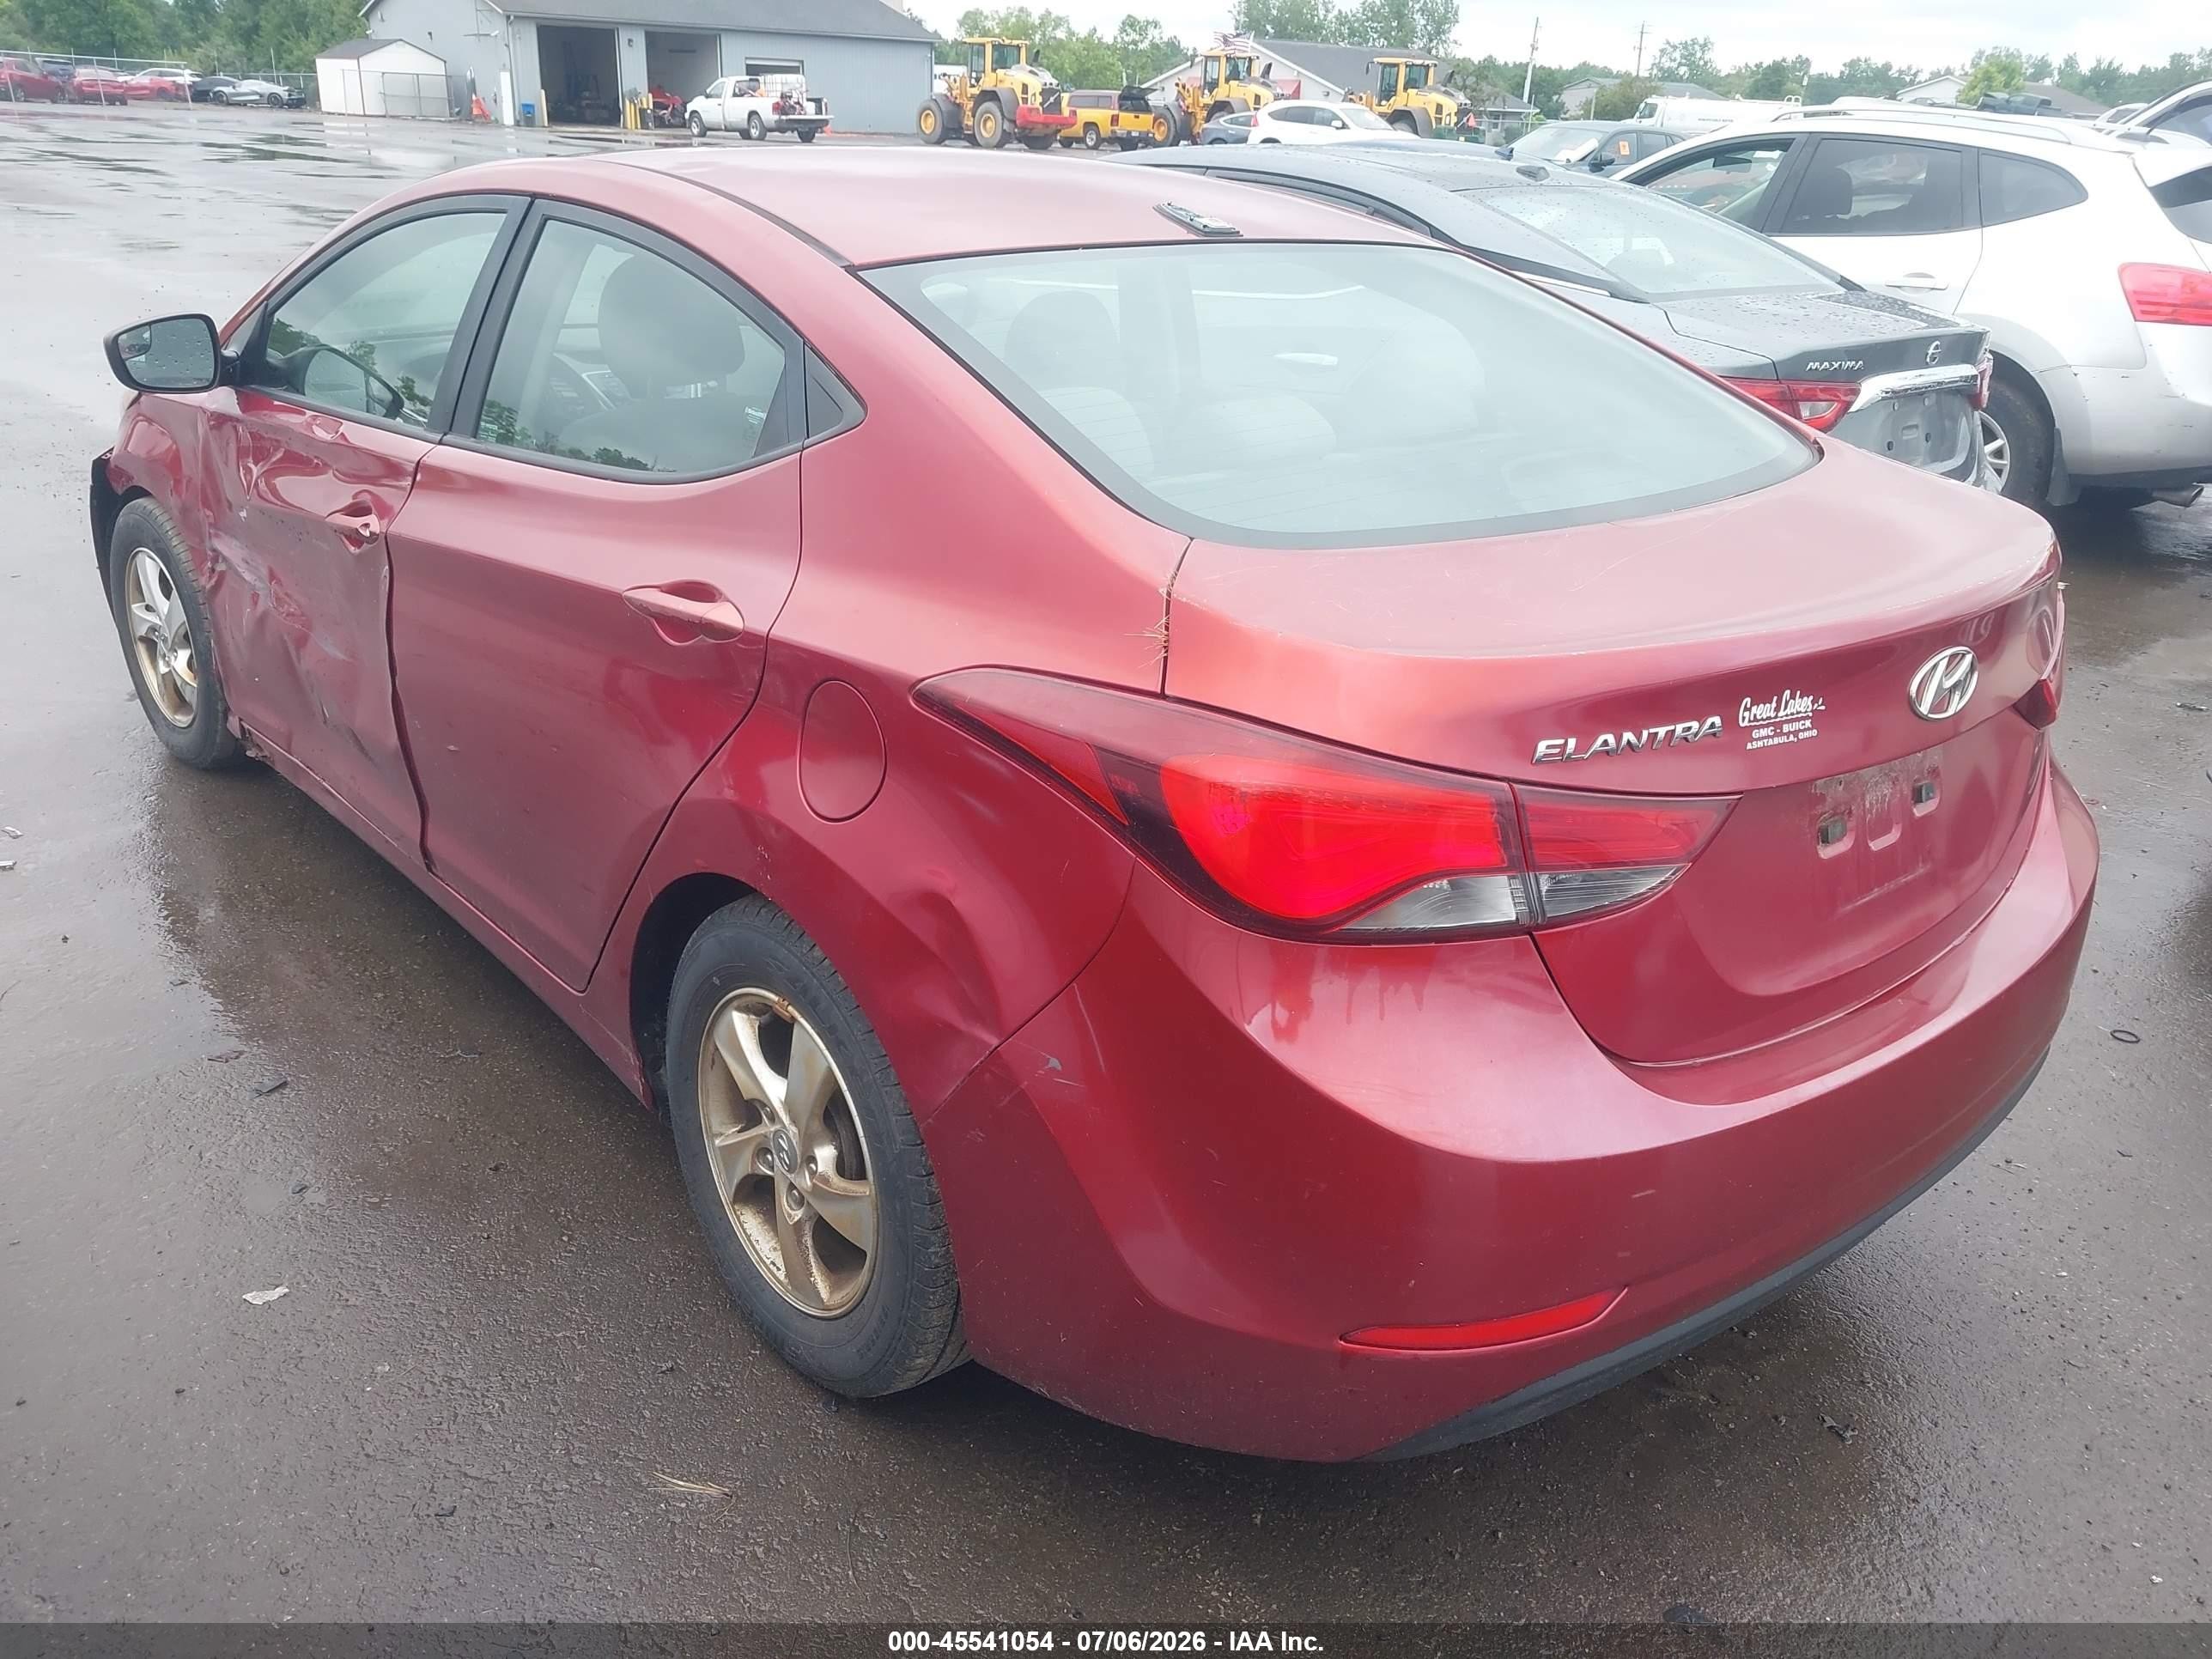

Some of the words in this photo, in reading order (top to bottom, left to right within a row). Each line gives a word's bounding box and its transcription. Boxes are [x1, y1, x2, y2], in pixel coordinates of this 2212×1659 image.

[1806, 360, 1864, 371] MAXIMA
[1738, 695, 1778, 727] Great
[1778, 689, 1814, 717] Lakes
[1531, 714, 1723, 764] ELANTRA
[1746, 733, 1797, 750] ASHTABULA,
[1798, 728, 1818, 740] OHIO
[1752, 726, 1775, 739] GMC
[1783, 719, 1812, 733] BUICK
